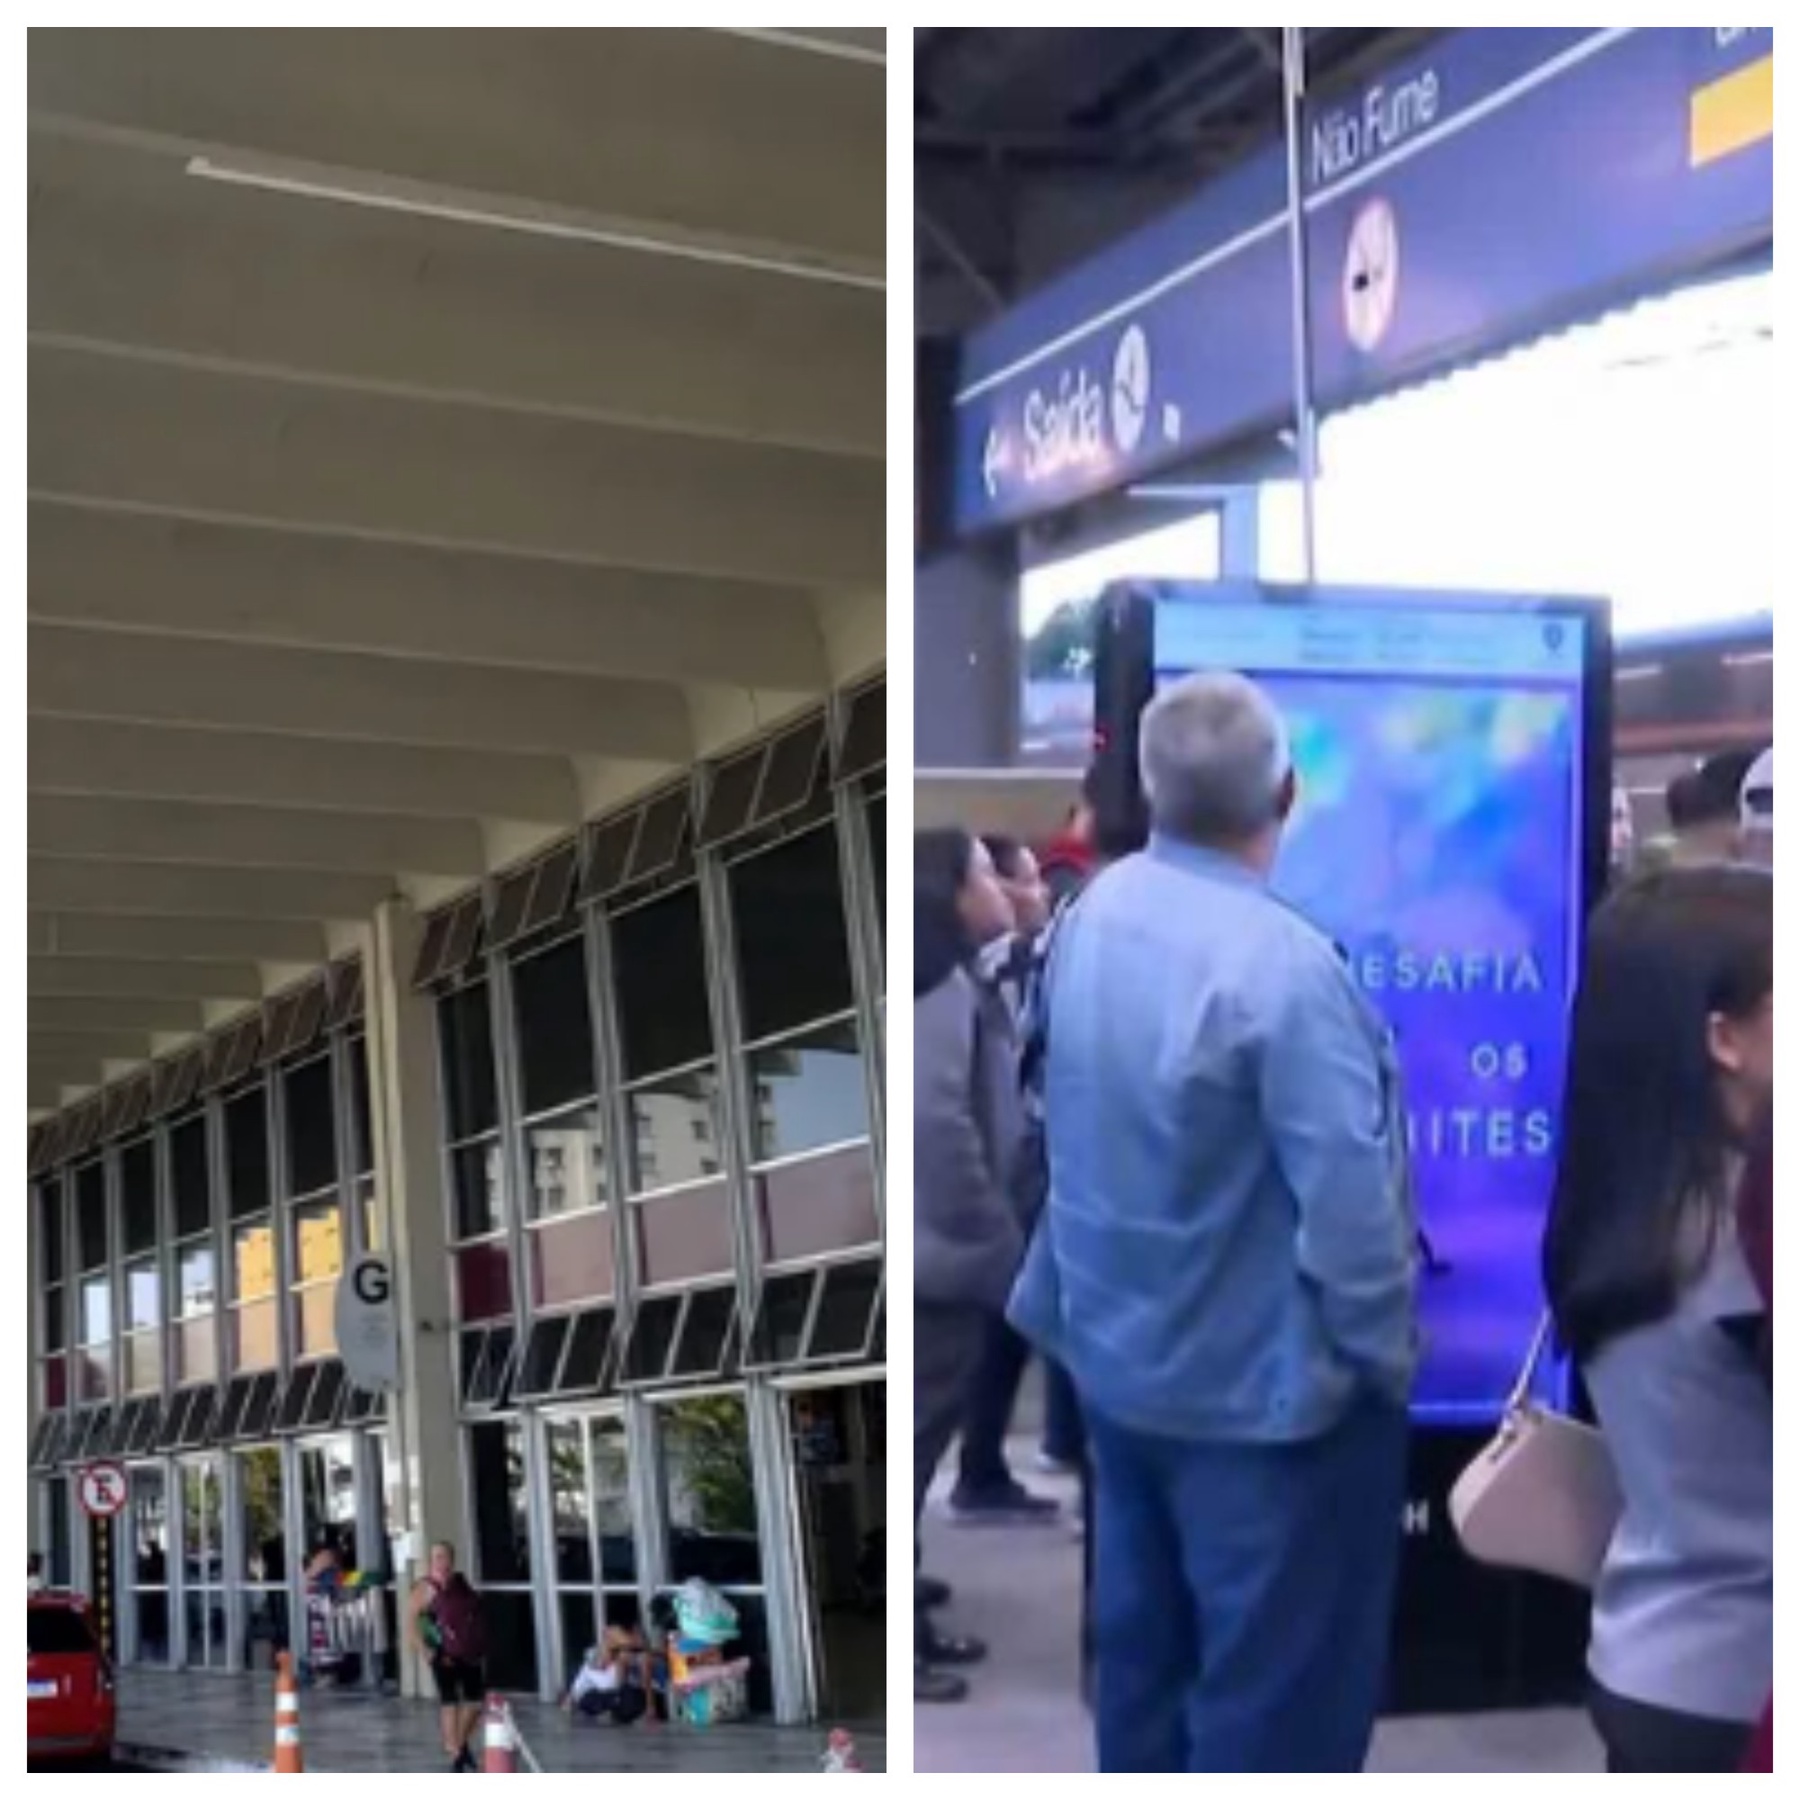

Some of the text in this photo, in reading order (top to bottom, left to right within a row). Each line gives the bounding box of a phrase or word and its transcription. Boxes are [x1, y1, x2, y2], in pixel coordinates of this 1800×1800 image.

[1311, 69, 1439, 185] Não Fume
[1021, 365, 1107, 483] Saída
[353, 1259, 390, 1306] G
